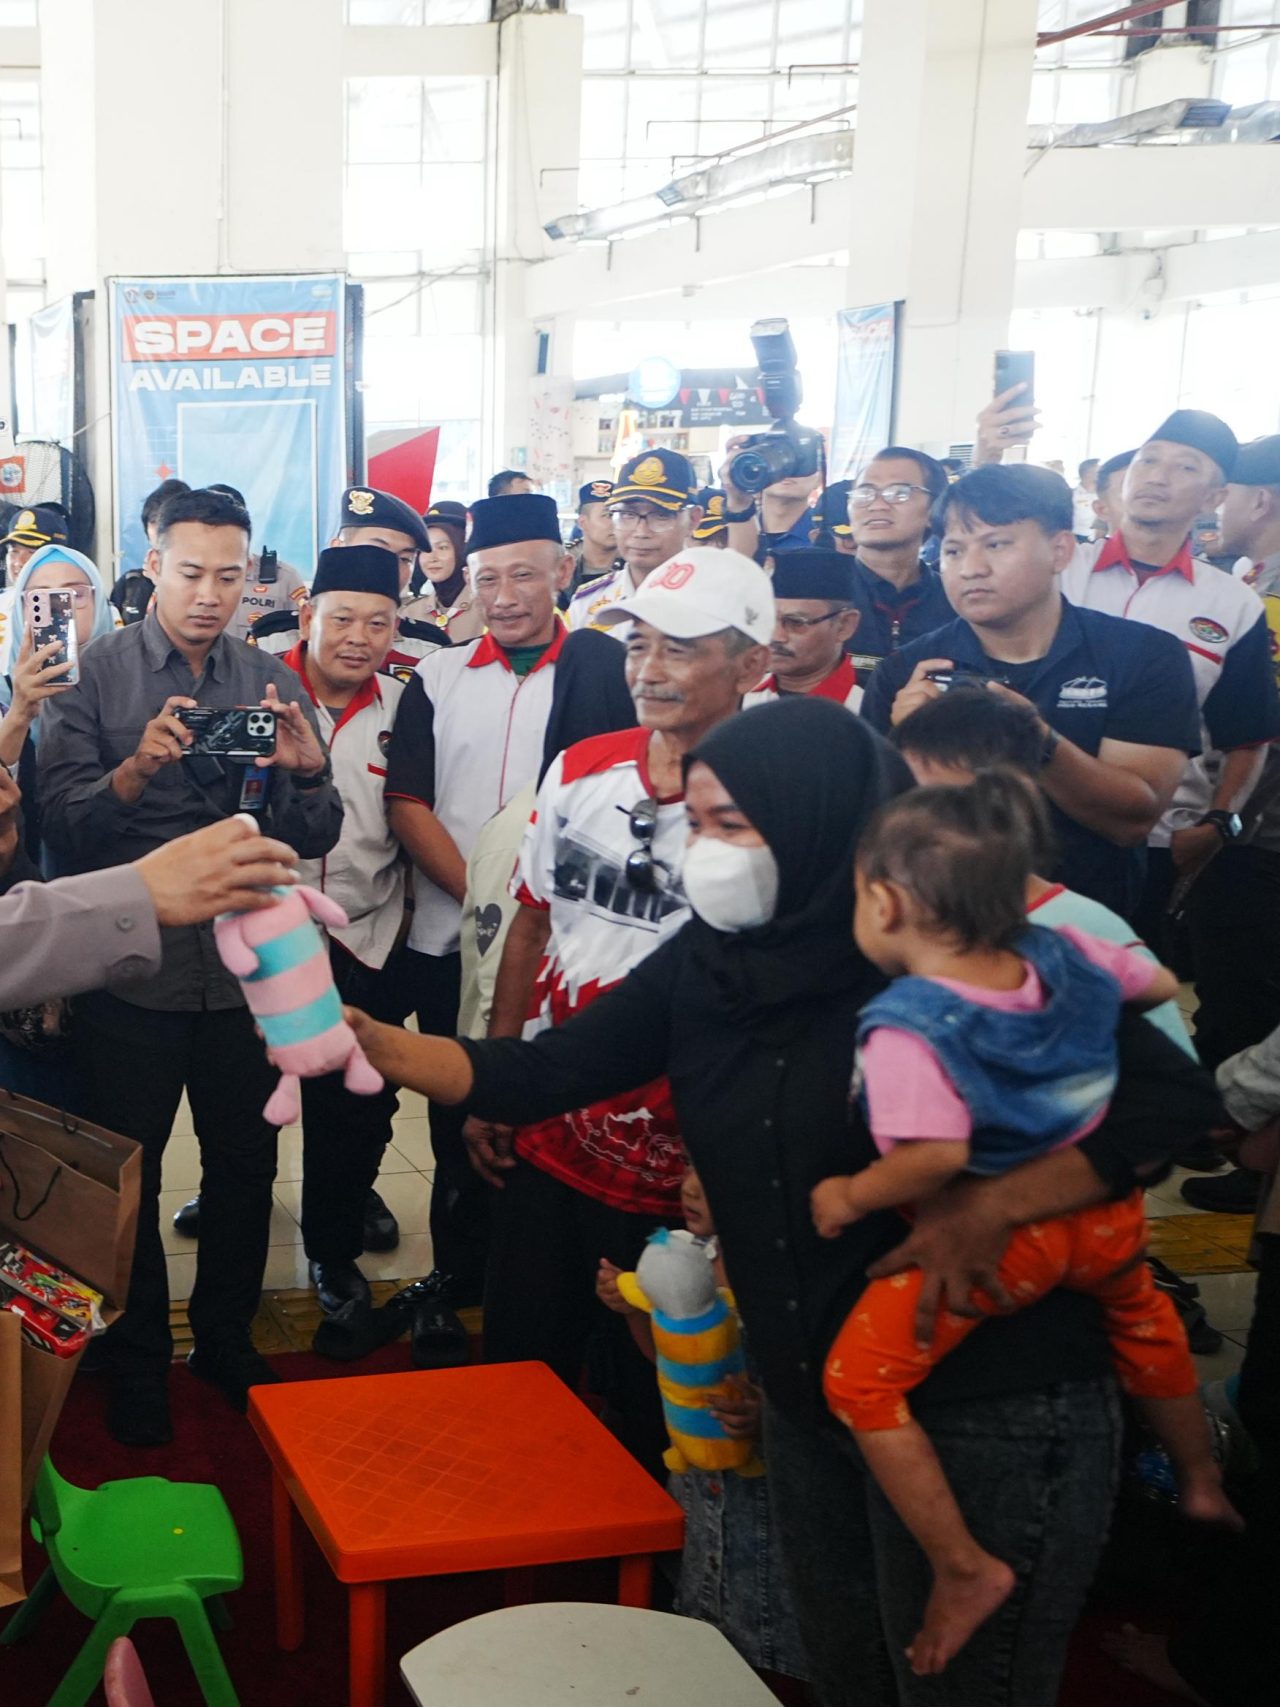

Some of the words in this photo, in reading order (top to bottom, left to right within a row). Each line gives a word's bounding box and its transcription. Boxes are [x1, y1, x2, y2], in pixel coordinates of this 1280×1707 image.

[133, 317, 327, 355] SPACE
[128, 364, 332, 392] AVAILABLE
[242, 596, 275, 608] POLRI
